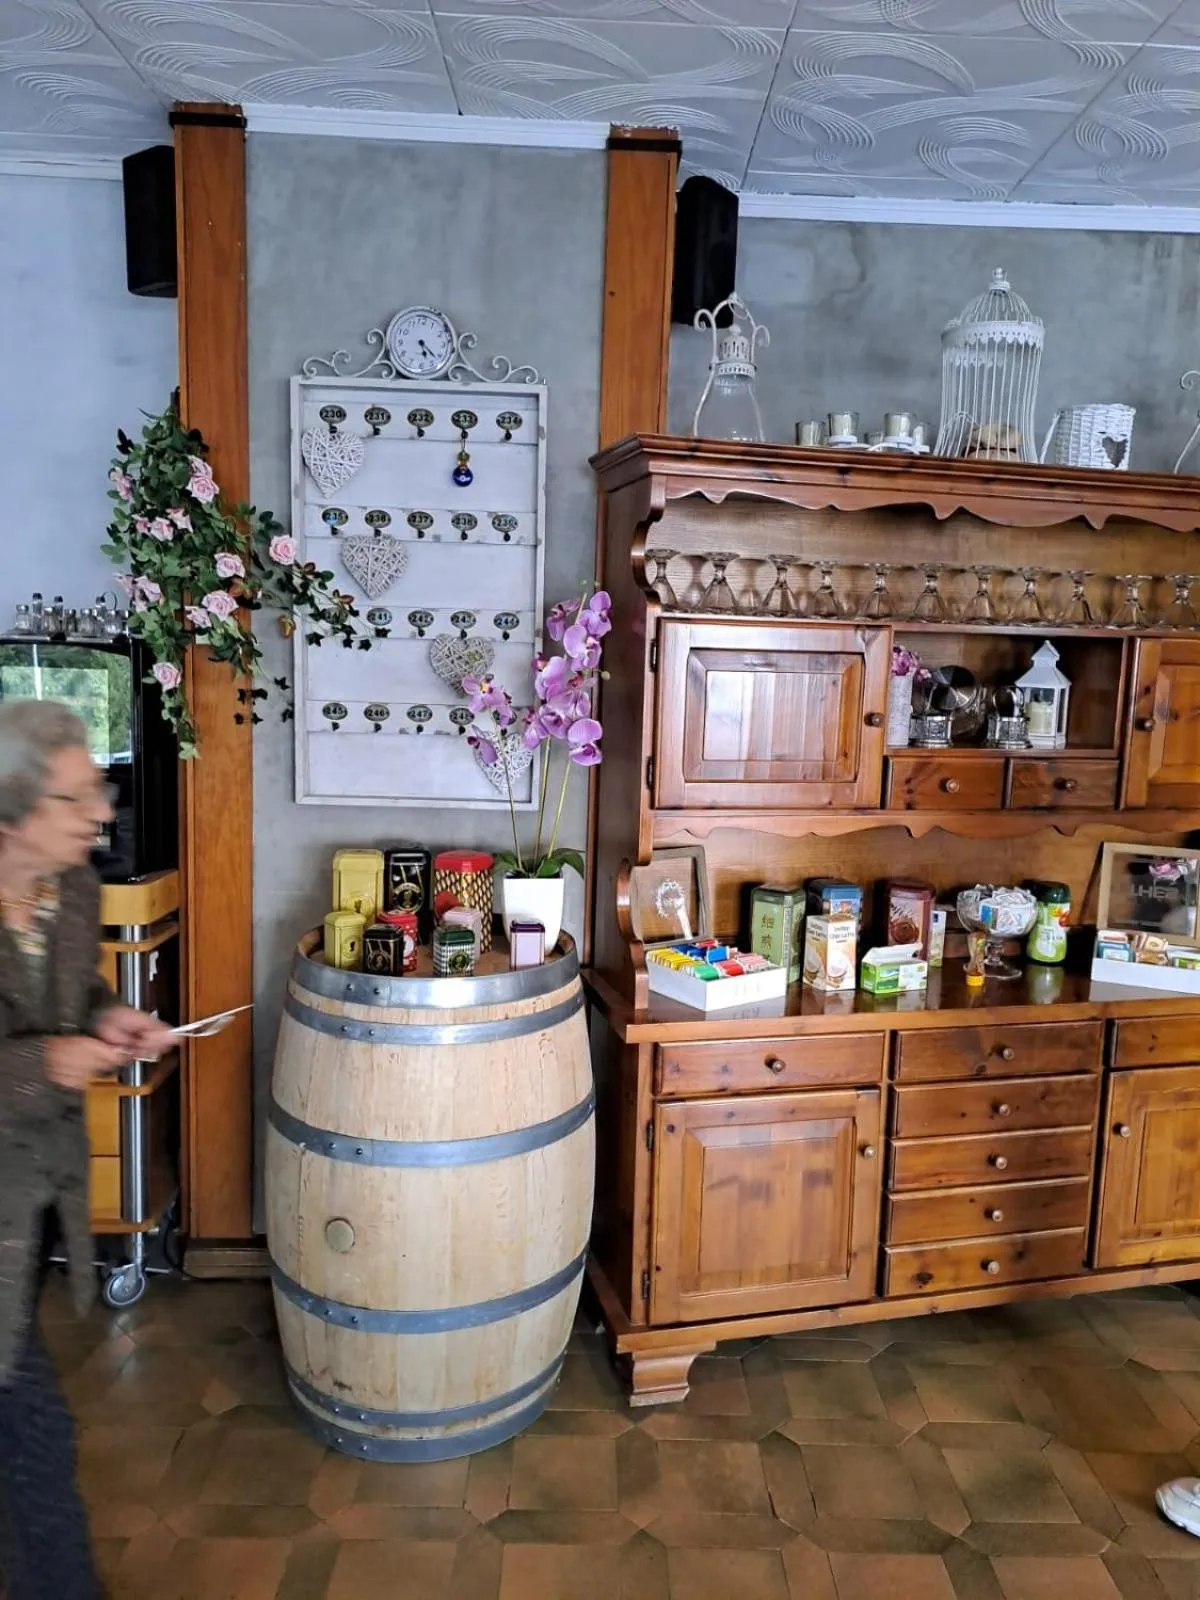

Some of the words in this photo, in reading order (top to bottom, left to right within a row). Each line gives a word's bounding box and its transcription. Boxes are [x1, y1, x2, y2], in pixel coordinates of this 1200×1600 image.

[417, 317, 427, 326] 12
[398, 328, 409, 336] 10
[324, 409, 342, 419] 230
[368, 411, 386, 421] 231
[412, 413, 430, 422] 232
[501, 415, 518, 425] 234
[326, 512, 344, 522] 235
[411, 514, 429, 524] 237
[371, 611, 388, 621] 241
[325, 706, 343, 716] 245
[368, 708, 385, 718] 246
[410, 709, 428, 718] 247
